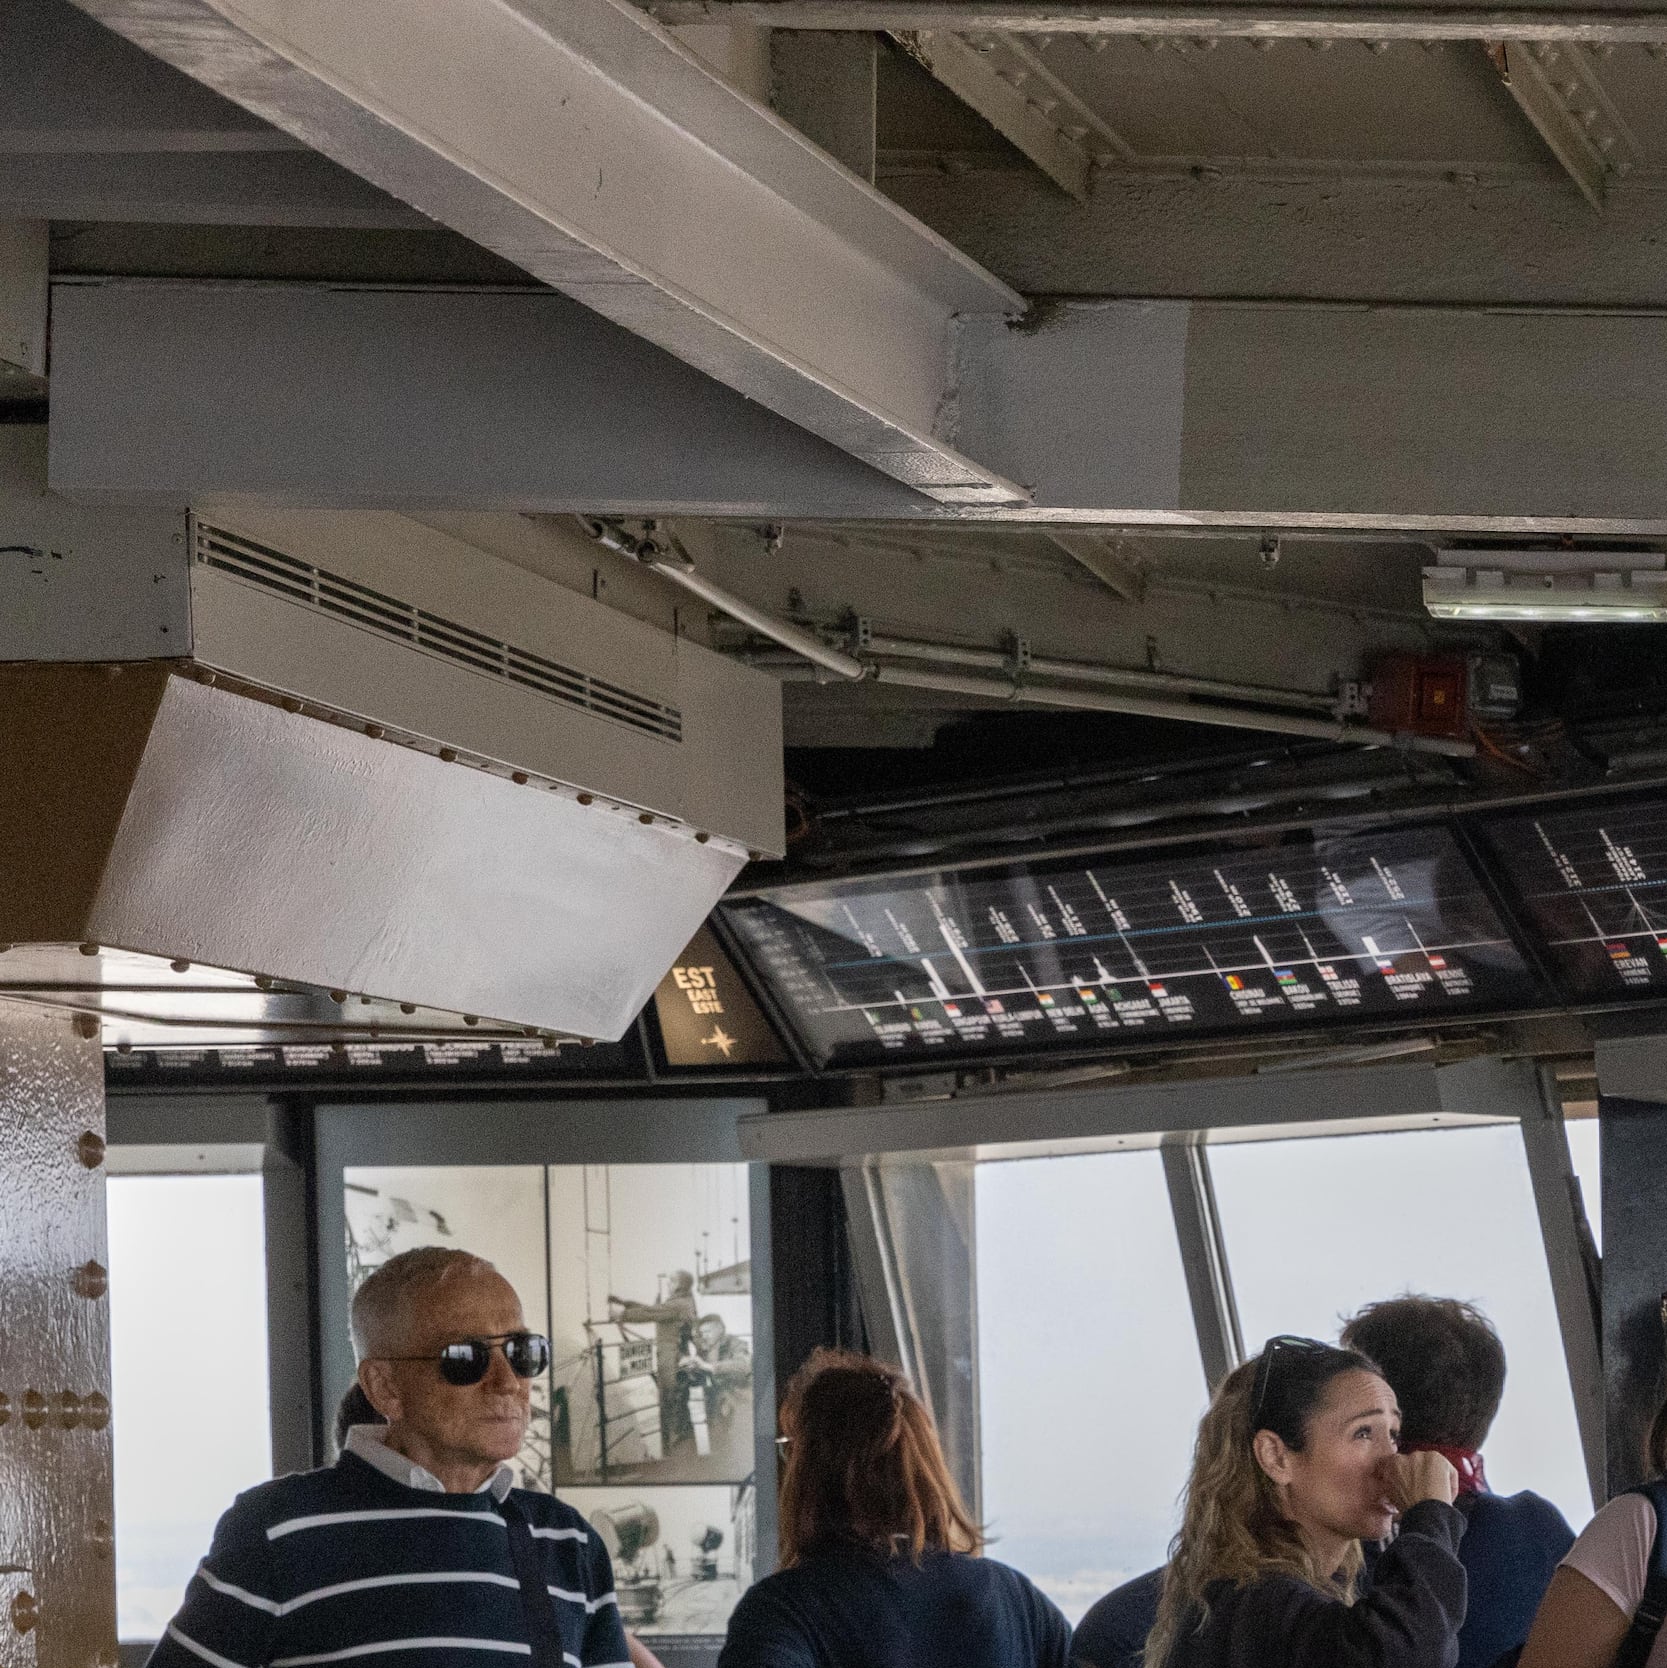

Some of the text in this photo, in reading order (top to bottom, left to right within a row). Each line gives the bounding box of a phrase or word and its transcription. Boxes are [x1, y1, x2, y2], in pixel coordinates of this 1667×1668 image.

[1622, 846, 1647, 879] 314 m
[1613, 957, 1648, 968] EREVAN
[672, 966, 716, 989] EST
[687, 989, 718, 1001] EAST
[693, 1001, 724, 1014] ESTE
